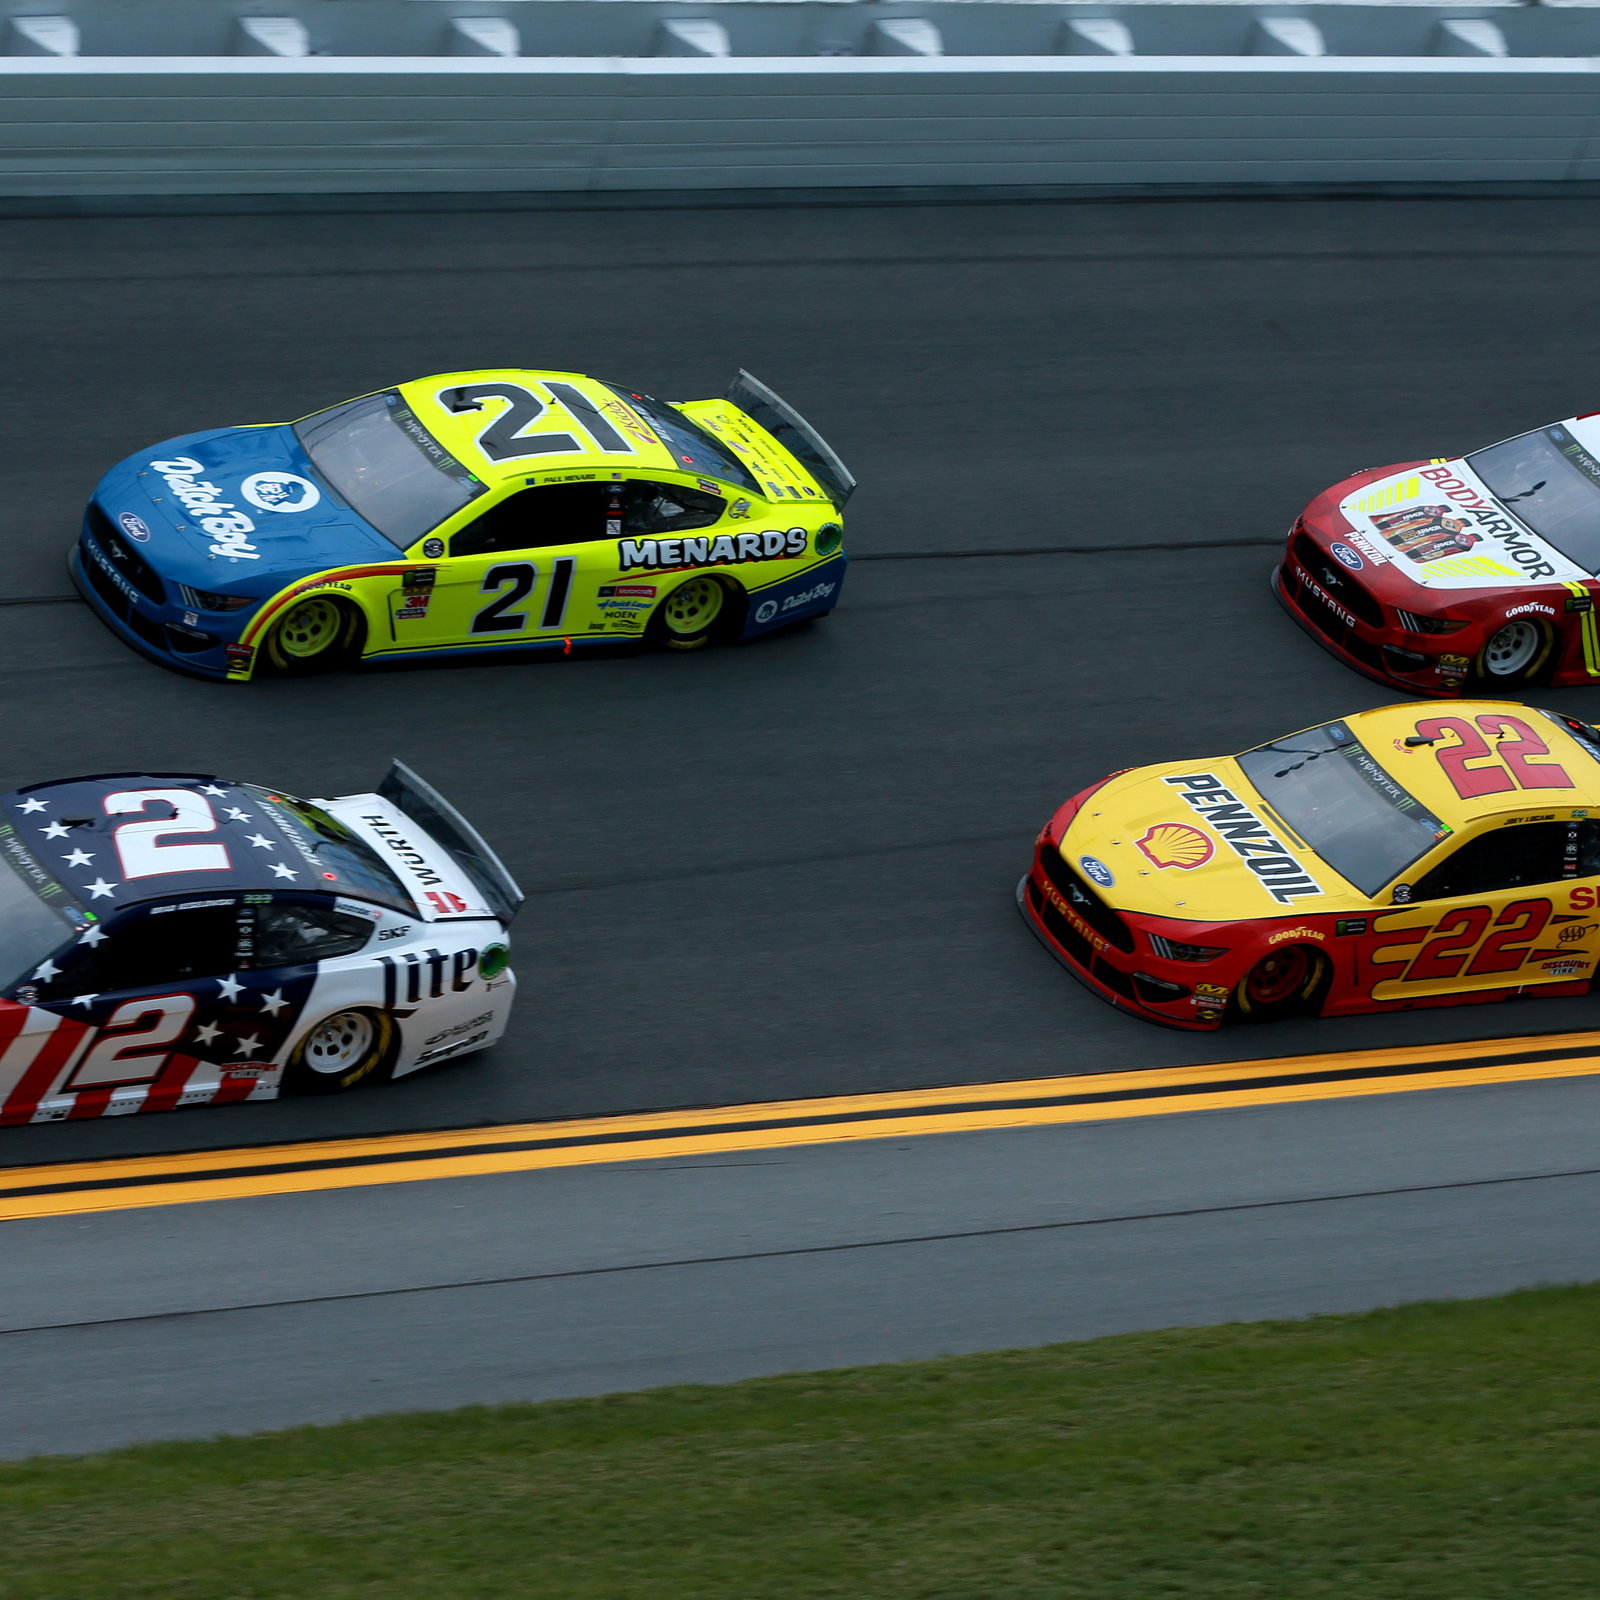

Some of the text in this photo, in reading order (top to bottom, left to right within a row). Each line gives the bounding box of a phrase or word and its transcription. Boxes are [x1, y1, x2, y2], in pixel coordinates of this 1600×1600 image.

[404, 418, 443, 464] MONSTER
[437, 381, 635, 464] 21
[543, 473, 596, 484] PAUL MENARD
[1576, 453, 1600, 480] MONS
[121, 514, 149, 541] Ford
[200, 510, 261, 562] Boy
[1420, 466, 1555, 580] BODYARMOR
[620, 528, 808, 570] MENARDS
[1332, 544, 1362, 569] Ford
[1343, 531, 1389, 568] PENNZOIL
[86, 539, 141, 603] MUSTANG
[469, 557, 575, 635] 21
[604, 611, 636, 619] MOEN
[1296, 564, 1355, 628] MUSTANG
[1505, 601, 1555, 618] GOODYEAR
[1356, 756, 1402, 800] MONSTER
[1414, 714, 1576, 800] 22
[104, 788, 232, 881] 2
[1165, 774, 1322, 903] PENNZOIL
[1503, 817, 1524, 825] JOEY
[1082, 858, 1112, 886] Ford
[379, 926, 411, 941] SKF
[1042, 881, 1104, 952] MUSTANG
[1269, 926, 1325, 945] GOODYEAR
[1402, 897, 1553, 981] 22
[1541, 960, 1590, 971] DISCOUNT
[1551, 967, 1577, 975] TIRE
[64, 993, 196, 1091] 2
